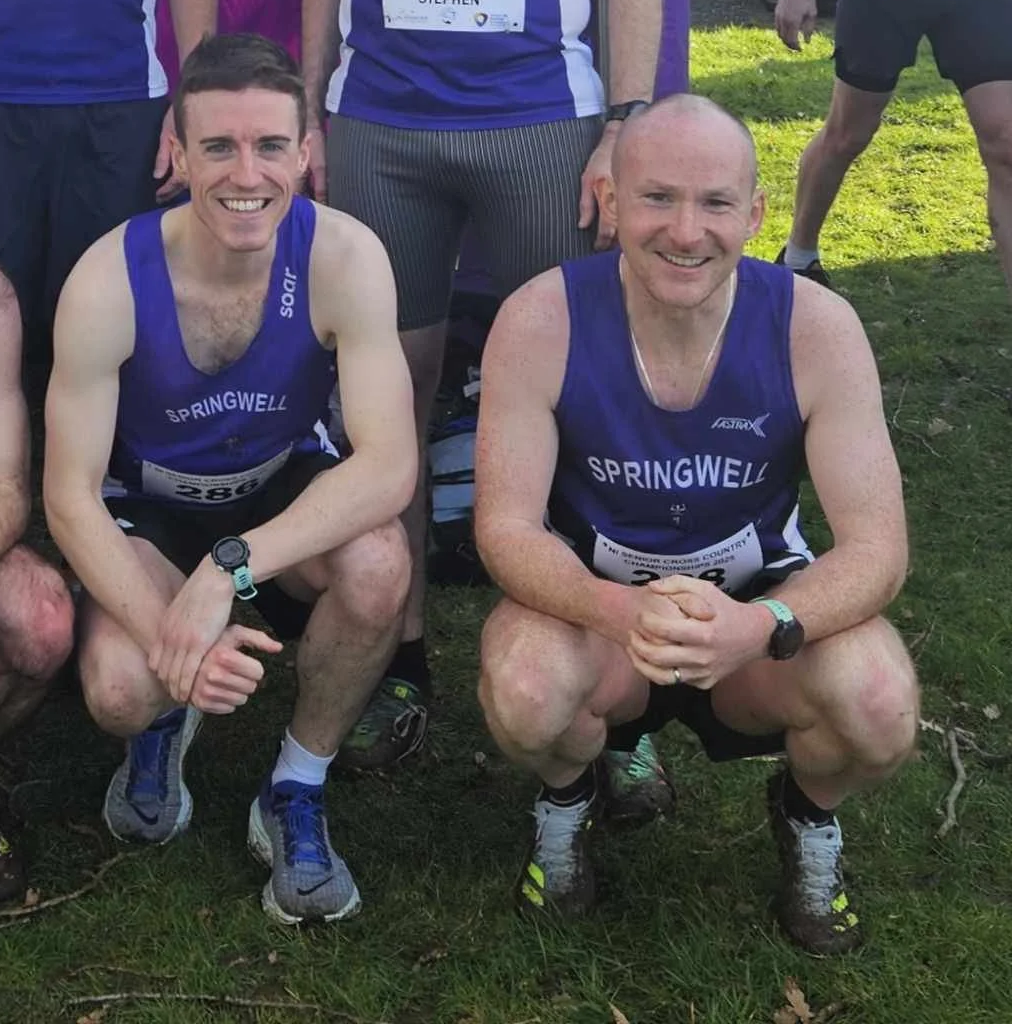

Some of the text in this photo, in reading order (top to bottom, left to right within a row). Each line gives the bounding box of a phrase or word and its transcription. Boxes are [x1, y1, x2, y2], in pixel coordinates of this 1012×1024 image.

[280, 267, 297, 318] soar
[165, 391, 287, 423] SPRINGWELL
[711, 413, 770, 438] FASTRAX
[588, 454, 769, 489] SPRINGWELL
[175, 478, 259, 501] 286
[608, 547, 618, 555] NI
[621, 551, 661, 564] SENIOR
[702, 538, 748, 561] COUNTRY
[631, 568, 726, 587] 28
